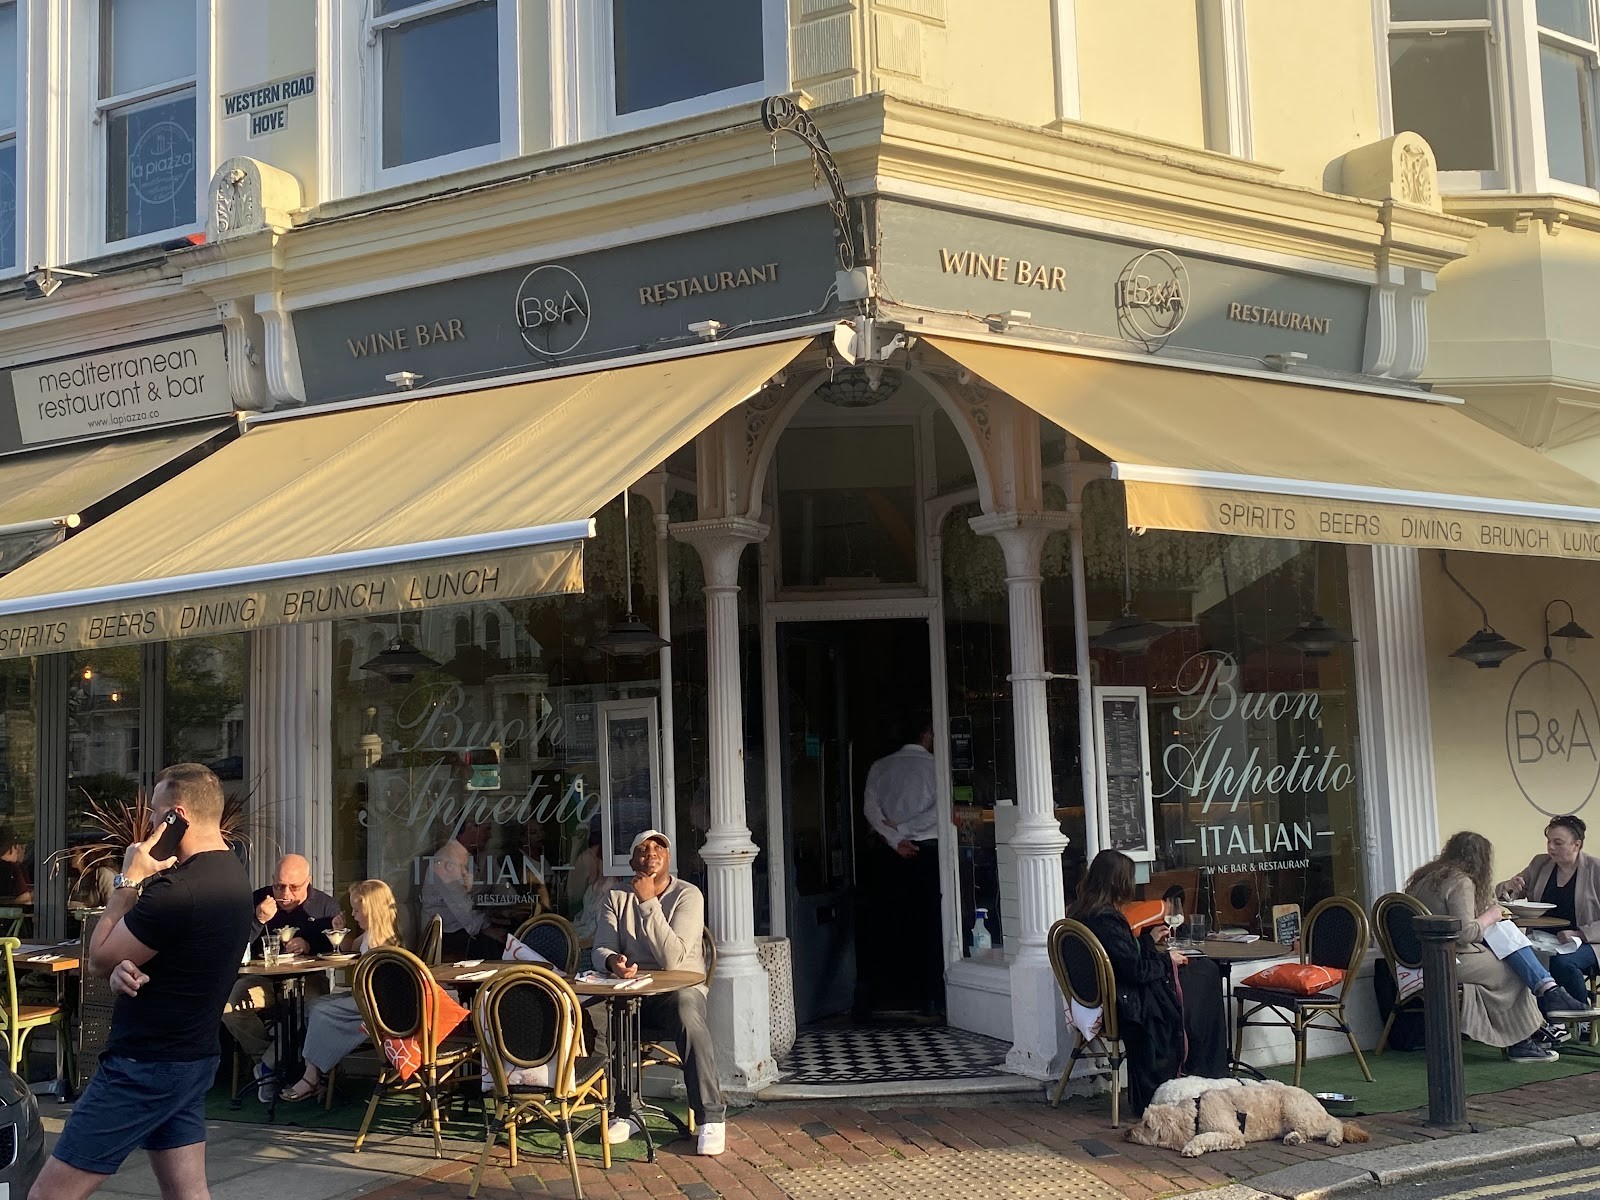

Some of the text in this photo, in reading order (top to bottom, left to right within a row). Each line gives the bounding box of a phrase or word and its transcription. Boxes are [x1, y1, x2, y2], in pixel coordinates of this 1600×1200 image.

[224, 75, 315, 115] WESTERN ROAD
[252, 110, 284, 135] HOVE
[131, 161, 144, 179] la
[145, 152, 192, 180] piazza
[638, 262, 779, 306] RESTAURANT
[939, 247, 1068, 292] WINE BAR
[520, 289, 587, 329] B&A
[1228, 302, 1333, 335] RESTAURANT
[346, 318, 466, 359] WINE BAR
[38, 348, 197, 393] mediterranean
[38, 374, 205, 420] restaurant & bar
[87, 409, 160, 428] www.lapiazza.co
[1219, 503, 1296, 531] SPIRITS
[1319, 511, 1381, 536] BEERS
[1401, 518, 1463, 543] DINING
[1480, 525, 1549, 549] BRUNCH
[0, 567, 500, 650] SPIRITS BEERS DINING BRUNCH LUNCH
[1172, 649, 1324, 721] Buon
[392, 681, 570, 753] Buon
[1514, 708, 1597, 764] B&A
[1150, 725, 1356, 813] Appetito
[1200, 821, 1313, 857] ITALIAN
[414, 854, 546, 885] ITLIAN
[1230, 862, 1248, 874] BAR
[1249, 862, 1257, 872] &
[1258, 859, 1310, 872] RESTAURANT
[477, 894, 541, 904] RESTAURANT
